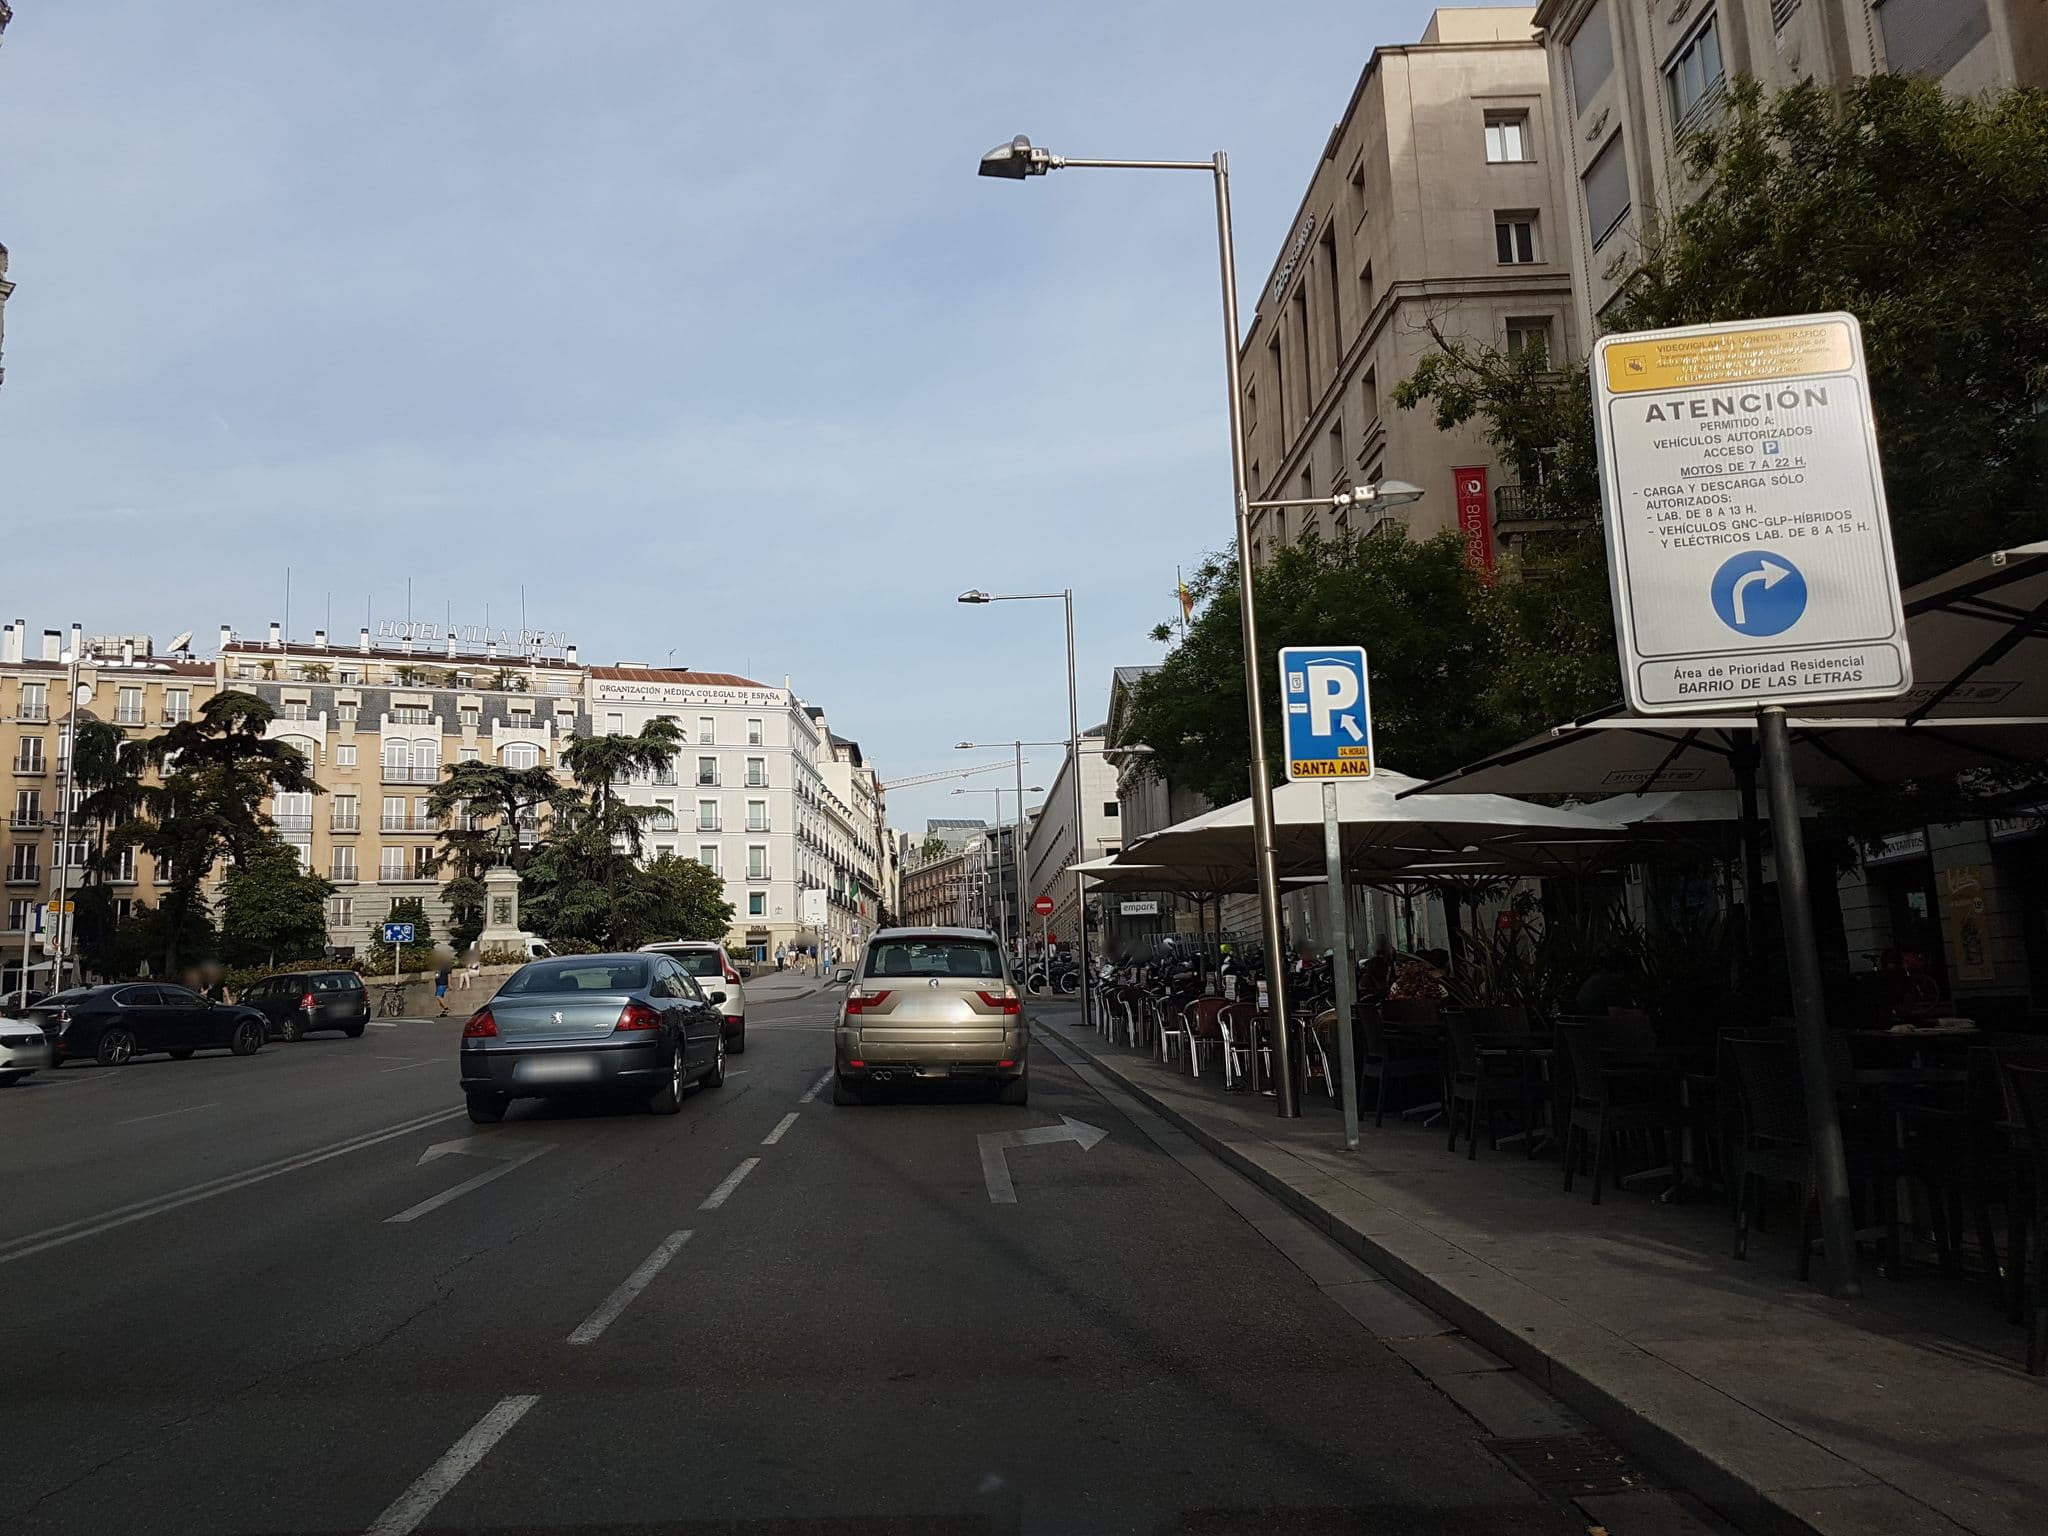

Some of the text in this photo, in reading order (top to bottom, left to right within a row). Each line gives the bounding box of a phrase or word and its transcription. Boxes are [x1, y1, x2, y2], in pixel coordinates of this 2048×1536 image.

[1645, 386, 1827, 423] ATENCIÓN
[1699, 416, 1759, 431] PERMITIDO
[1653, 425, 1812, 449] VEHÍCULOS AUTORIZADOS
[1703, 444, 1753, 458] ACCESO
[1680, 455, 1806, 476] MOTOS DE 7 A 22 H.
[1643, 472, 1803, 497] CARGA Y DESCARGA SÓLO
[1646, 493, 1731, 510] AUTORIZADOS:
[1656, 504, 1756, 521] LAB. DE 8 A 13 H.
[1658, 509, 1852, 536] VEHÍCULOS GNC-GLP-HÍBRIDOS
[1660, 521, 1869, 548] Y ELÉCTRICOS LAB. DE 8 A 15 H.
[377, 620, 569, 648] HOTEL VILLA REAL
[1673, 654, 1864, 679] Área de Prioridad Residencial
[600, 684, 781, 701] ORGANIZACIÓN MÉDICA COLEGIAL DE ESPAÑA
[1678, 669, 1862, 694] BARRIO DE LAS LETRAS
[1307, 665, 1359, 736] P
[1293, 761, 1368, 775] SANTA ANA
[1123, 903, 1154, 913] empark
